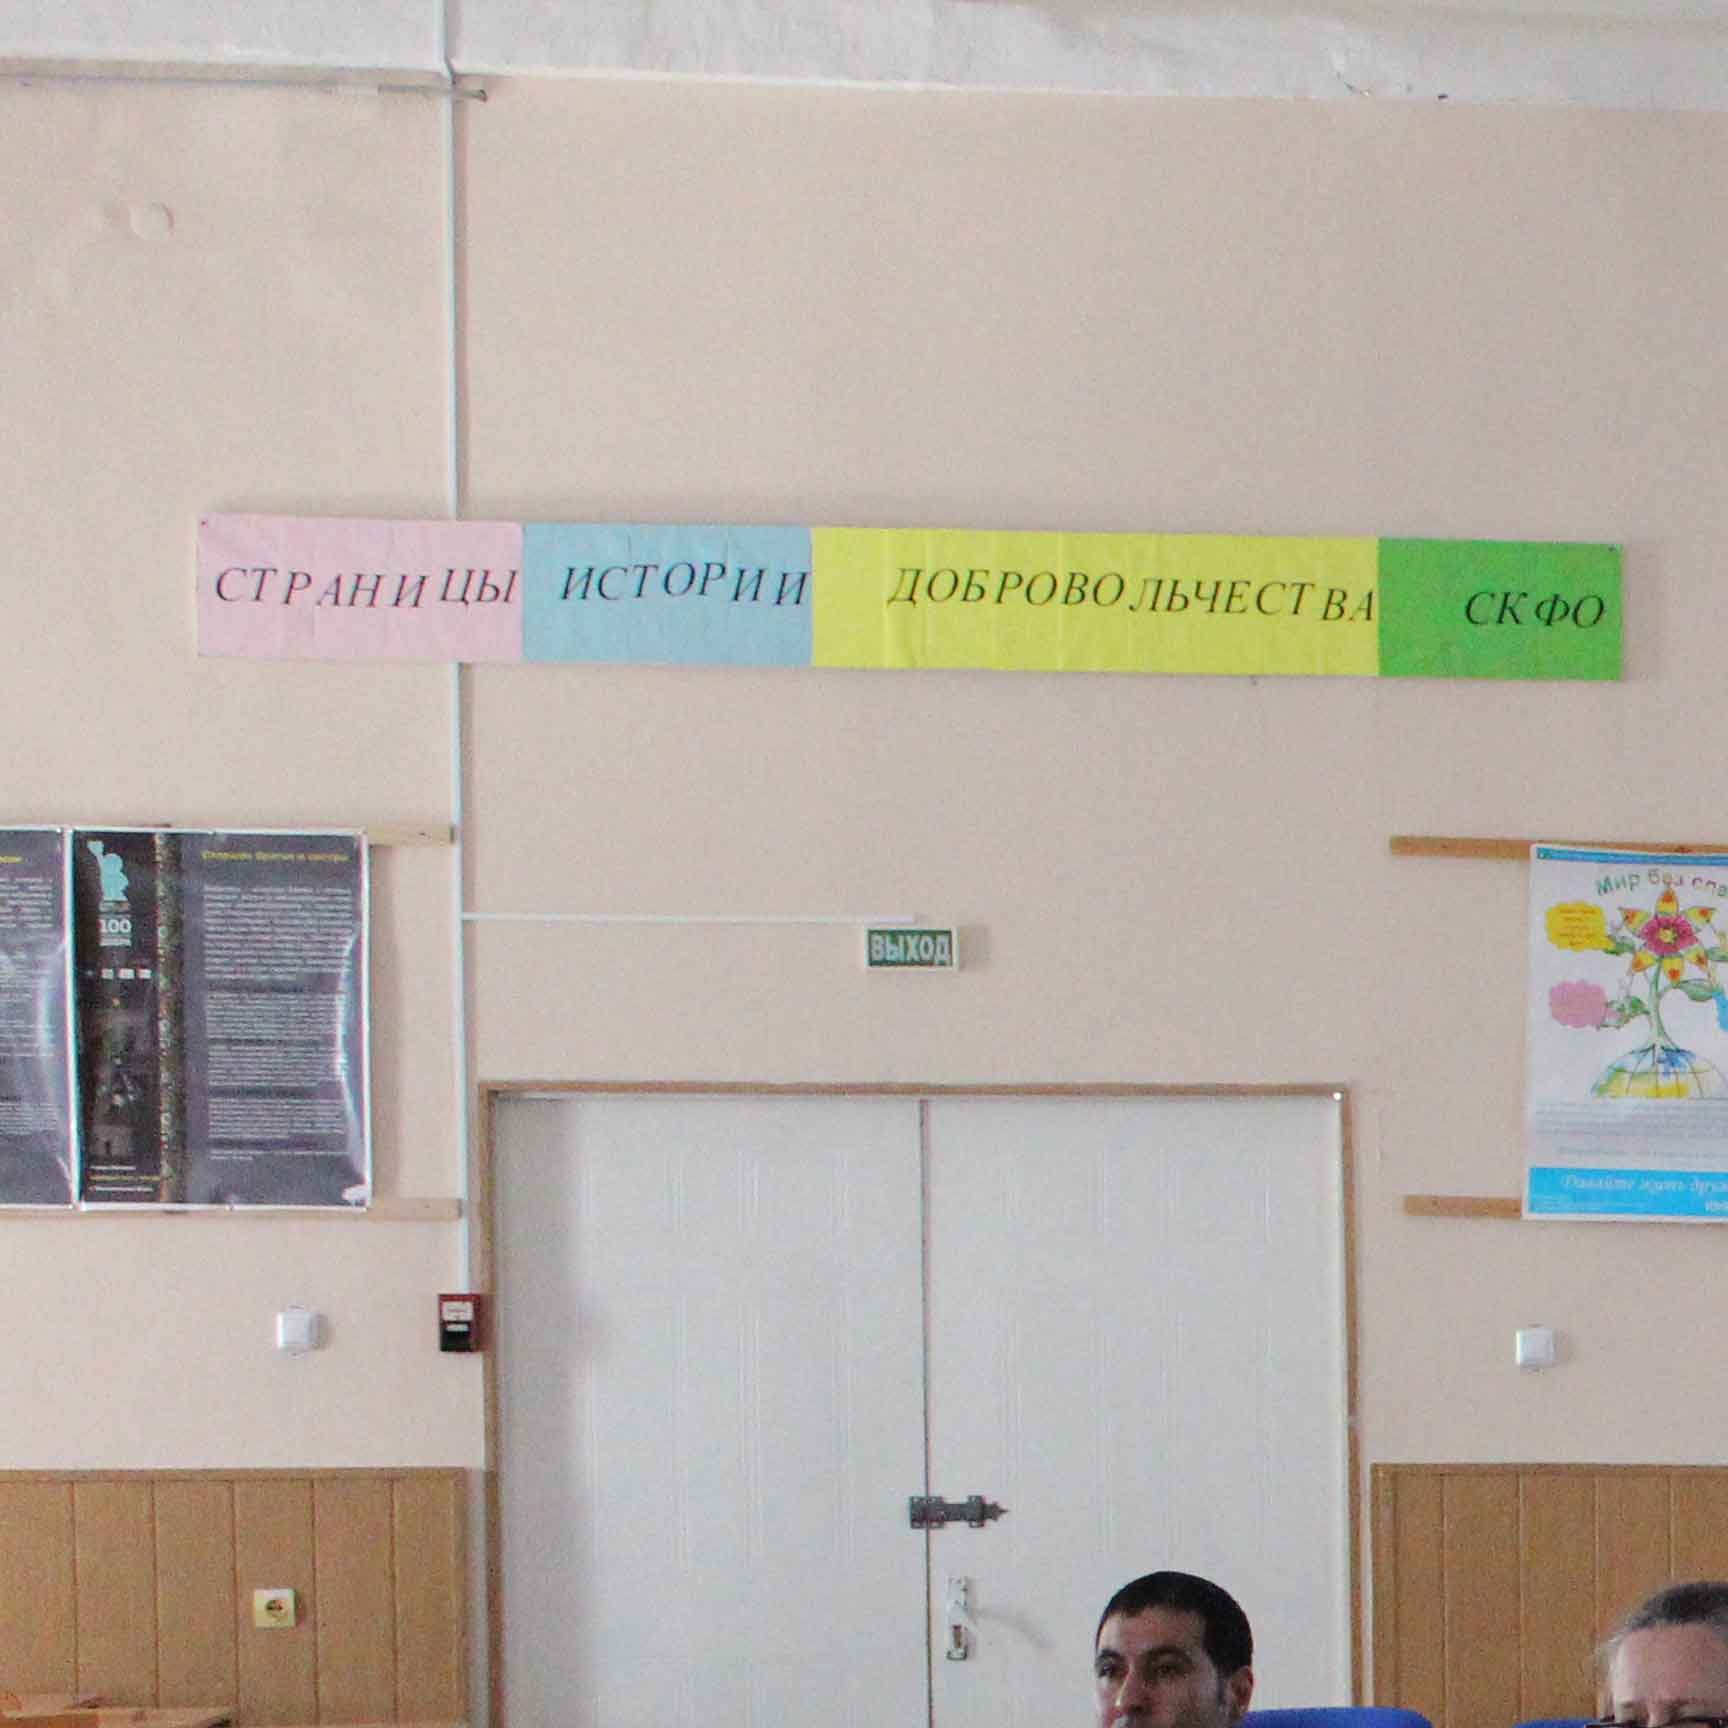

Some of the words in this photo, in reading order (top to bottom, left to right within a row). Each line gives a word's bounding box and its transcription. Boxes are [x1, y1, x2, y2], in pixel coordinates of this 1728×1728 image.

[215, 566, 518, 610] СТРАНИЦЫ
[559, 562, 810, 607] ИСТОРИИ
[887, 566, 1374, 623] ДОБРОВОЛЬЧЕСТВА
[1465, 589, 1606, 630] СКФО
[100, 920, 132, 933] 100
[870, 934, 952, 966] ВЫХОД
